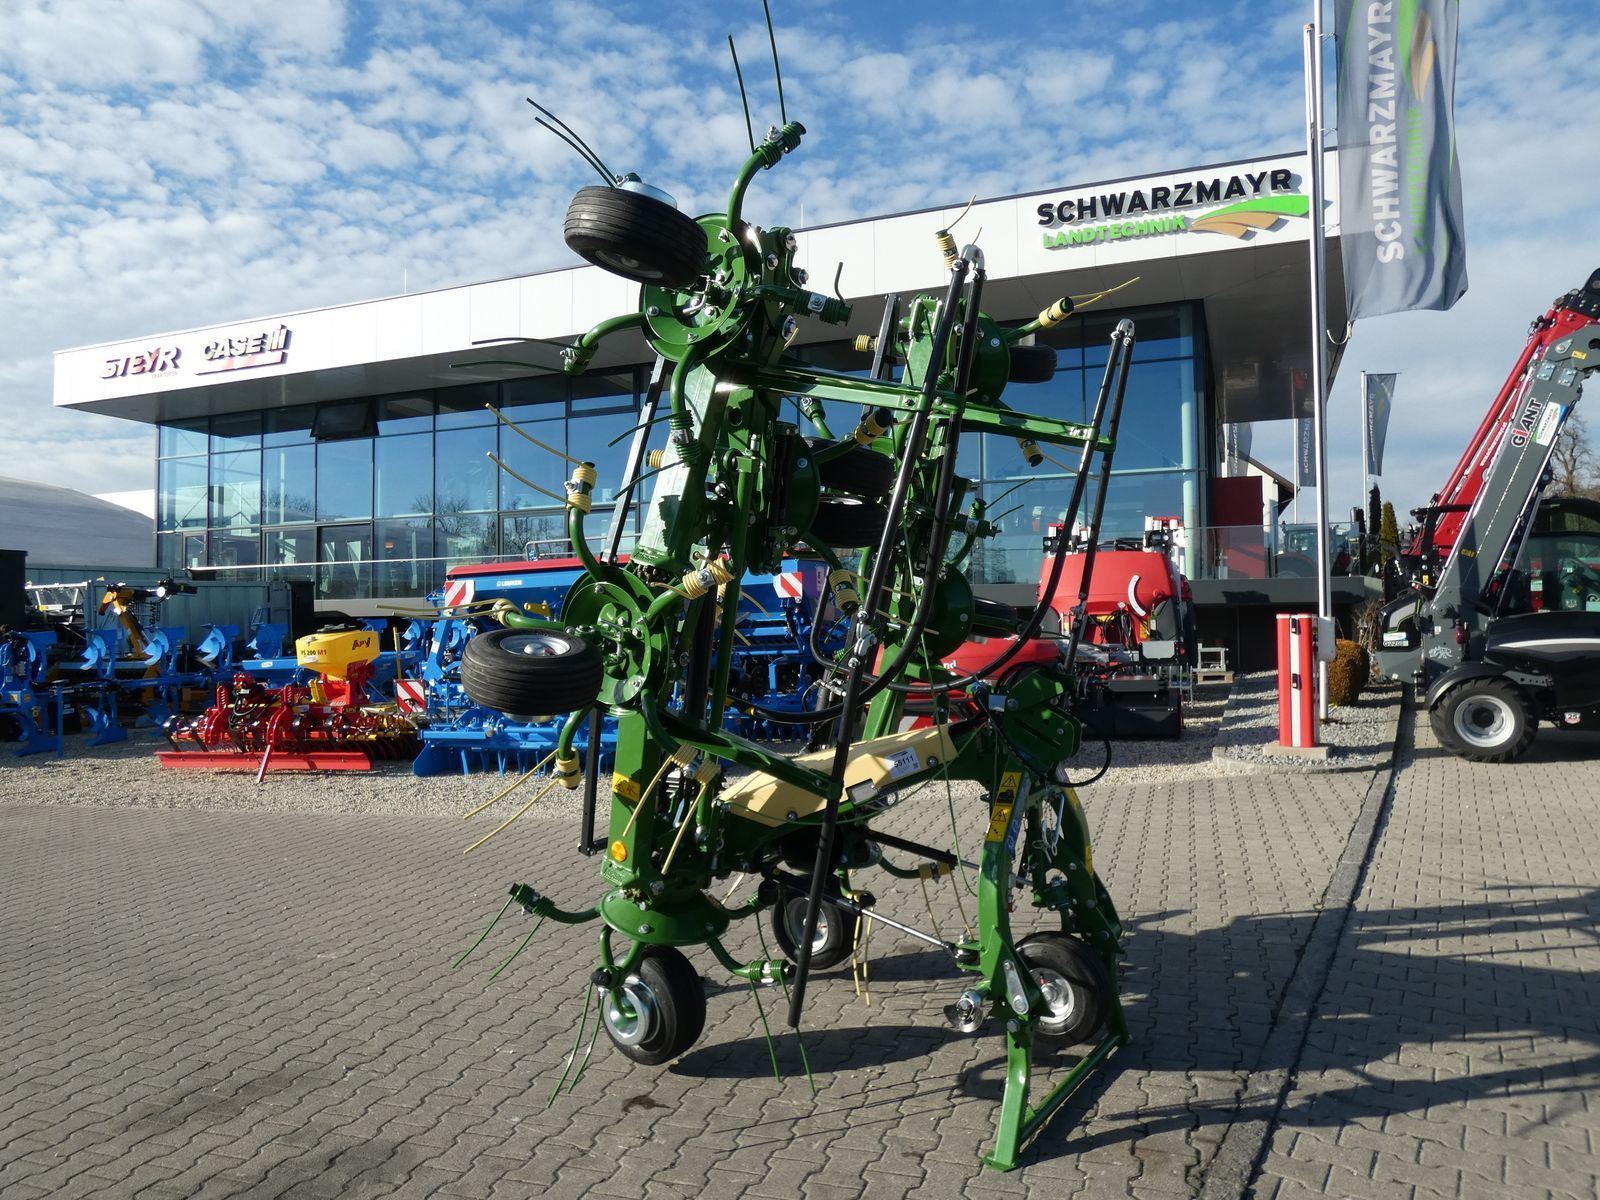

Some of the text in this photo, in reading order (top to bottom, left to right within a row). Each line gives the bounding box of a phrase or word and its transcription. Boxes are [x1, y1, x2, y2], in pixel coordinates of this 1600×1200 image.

[1367, 1, 1404, 263] SCHWARZMAYR
[1037, 169, 1292, 227] SCHWARZMAYR
[1043, 214, 1188, 249] LANDTECHNIK
[100, 347, 182, 379] STEYR
[204, 333, 268, 361] CASE
[1513, 398, 1542, 447] GIANT
